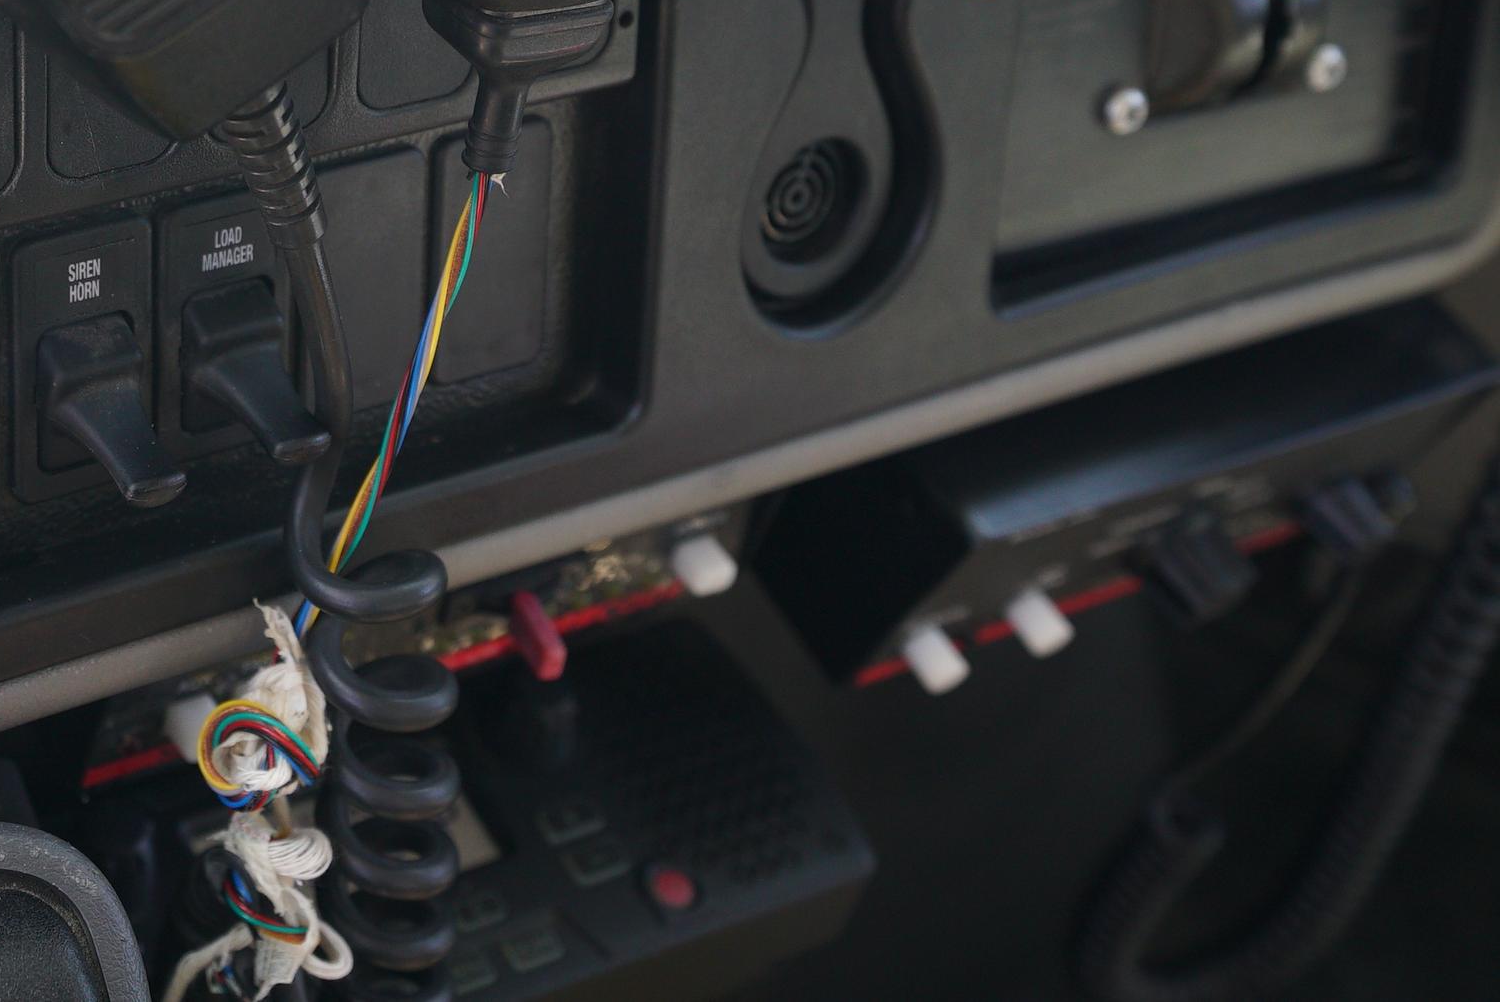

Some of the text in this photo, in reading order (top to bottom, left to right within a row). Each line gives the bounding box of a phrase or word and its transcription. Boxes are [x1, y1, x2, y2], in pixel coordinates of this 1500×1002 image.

[214, 226, 242, 248] LOAD
[68, 258, 101, 283] SIREN
[202, 244, 254, 273] MANAGER
[69, 279, 100, 303] HORN
